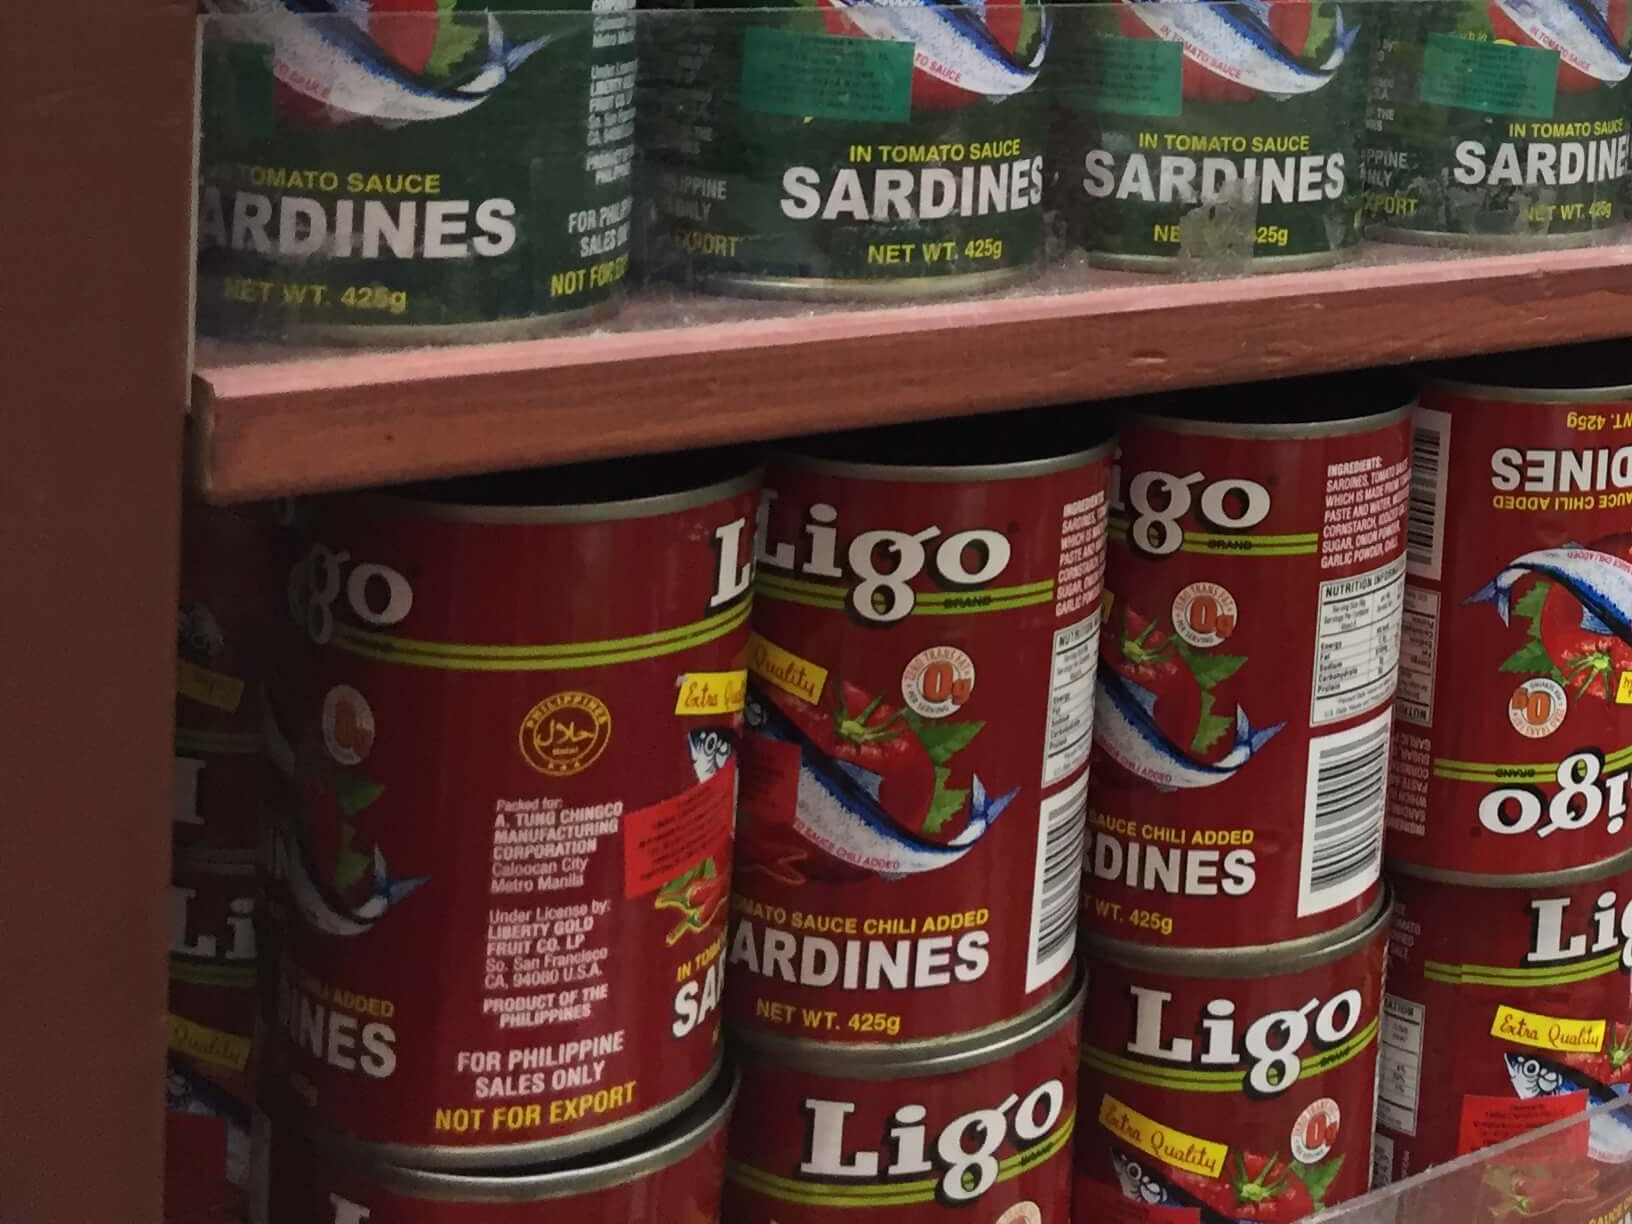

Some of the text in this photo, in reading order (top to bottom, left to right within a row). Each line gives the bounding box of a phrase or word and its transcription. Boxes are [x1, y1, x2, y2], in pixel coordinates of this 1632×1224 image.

[1508, 118, 1625, 139] IN TOMATO SAUCE
[849, 138, 1022, 164] IN TOMATO SAUCE
[1138, 132, 1311, 154] IN TOMATO SAUCE
[1453, 133, 1630, 188] SARDINE
[347, 173, 442, 195] SAUCE
[780, 155, 1044, 223] SARDINES
[1082, 149, 1346, 207] SARDINES
[202, 181, 518, 260] ARDINES
[867, 238, 1004, 265] NET 425g
[1492, 493, 1594, 512] CHILI ADDED
[755, 486, 1012, 624] Ligo
[494, 818, 620, 845] MANUFACTURING
[1190, 825, 1255, 849] ADDED
[493, 838, 598, 861] CORPORATION
[561, 857, 589, 874] City
[489, 902, 588, 925] Under License
[791, 907, 990, 936] SAUCE CHILI ADDED
[1129, 909, 1174, 936] 425g
[487, 915, 594, 941] LIBERTY GOLD
[487, 940, 532, 957] FRUIT
[729, 929, 991, 992] ARDINES
[483, 983, 609, 1014] PRODUCT THE
[499, 1003, 592, 1030] PHILIPPINES
[755, 998, 902, 1037] NET WT. 425g
[1128, 984, 1364, 1097] Ligo
[1541, 1018, 1602, 1055] Quality
[457, 1029, 626, 1073] FOR PHILIPPINE
[475, 1059, 606, 1099] SALES ONLY
[435, 1080, 637, 1132] NOT FOR EXPORT
[800, 1077, 1066, 1202] Ligo
